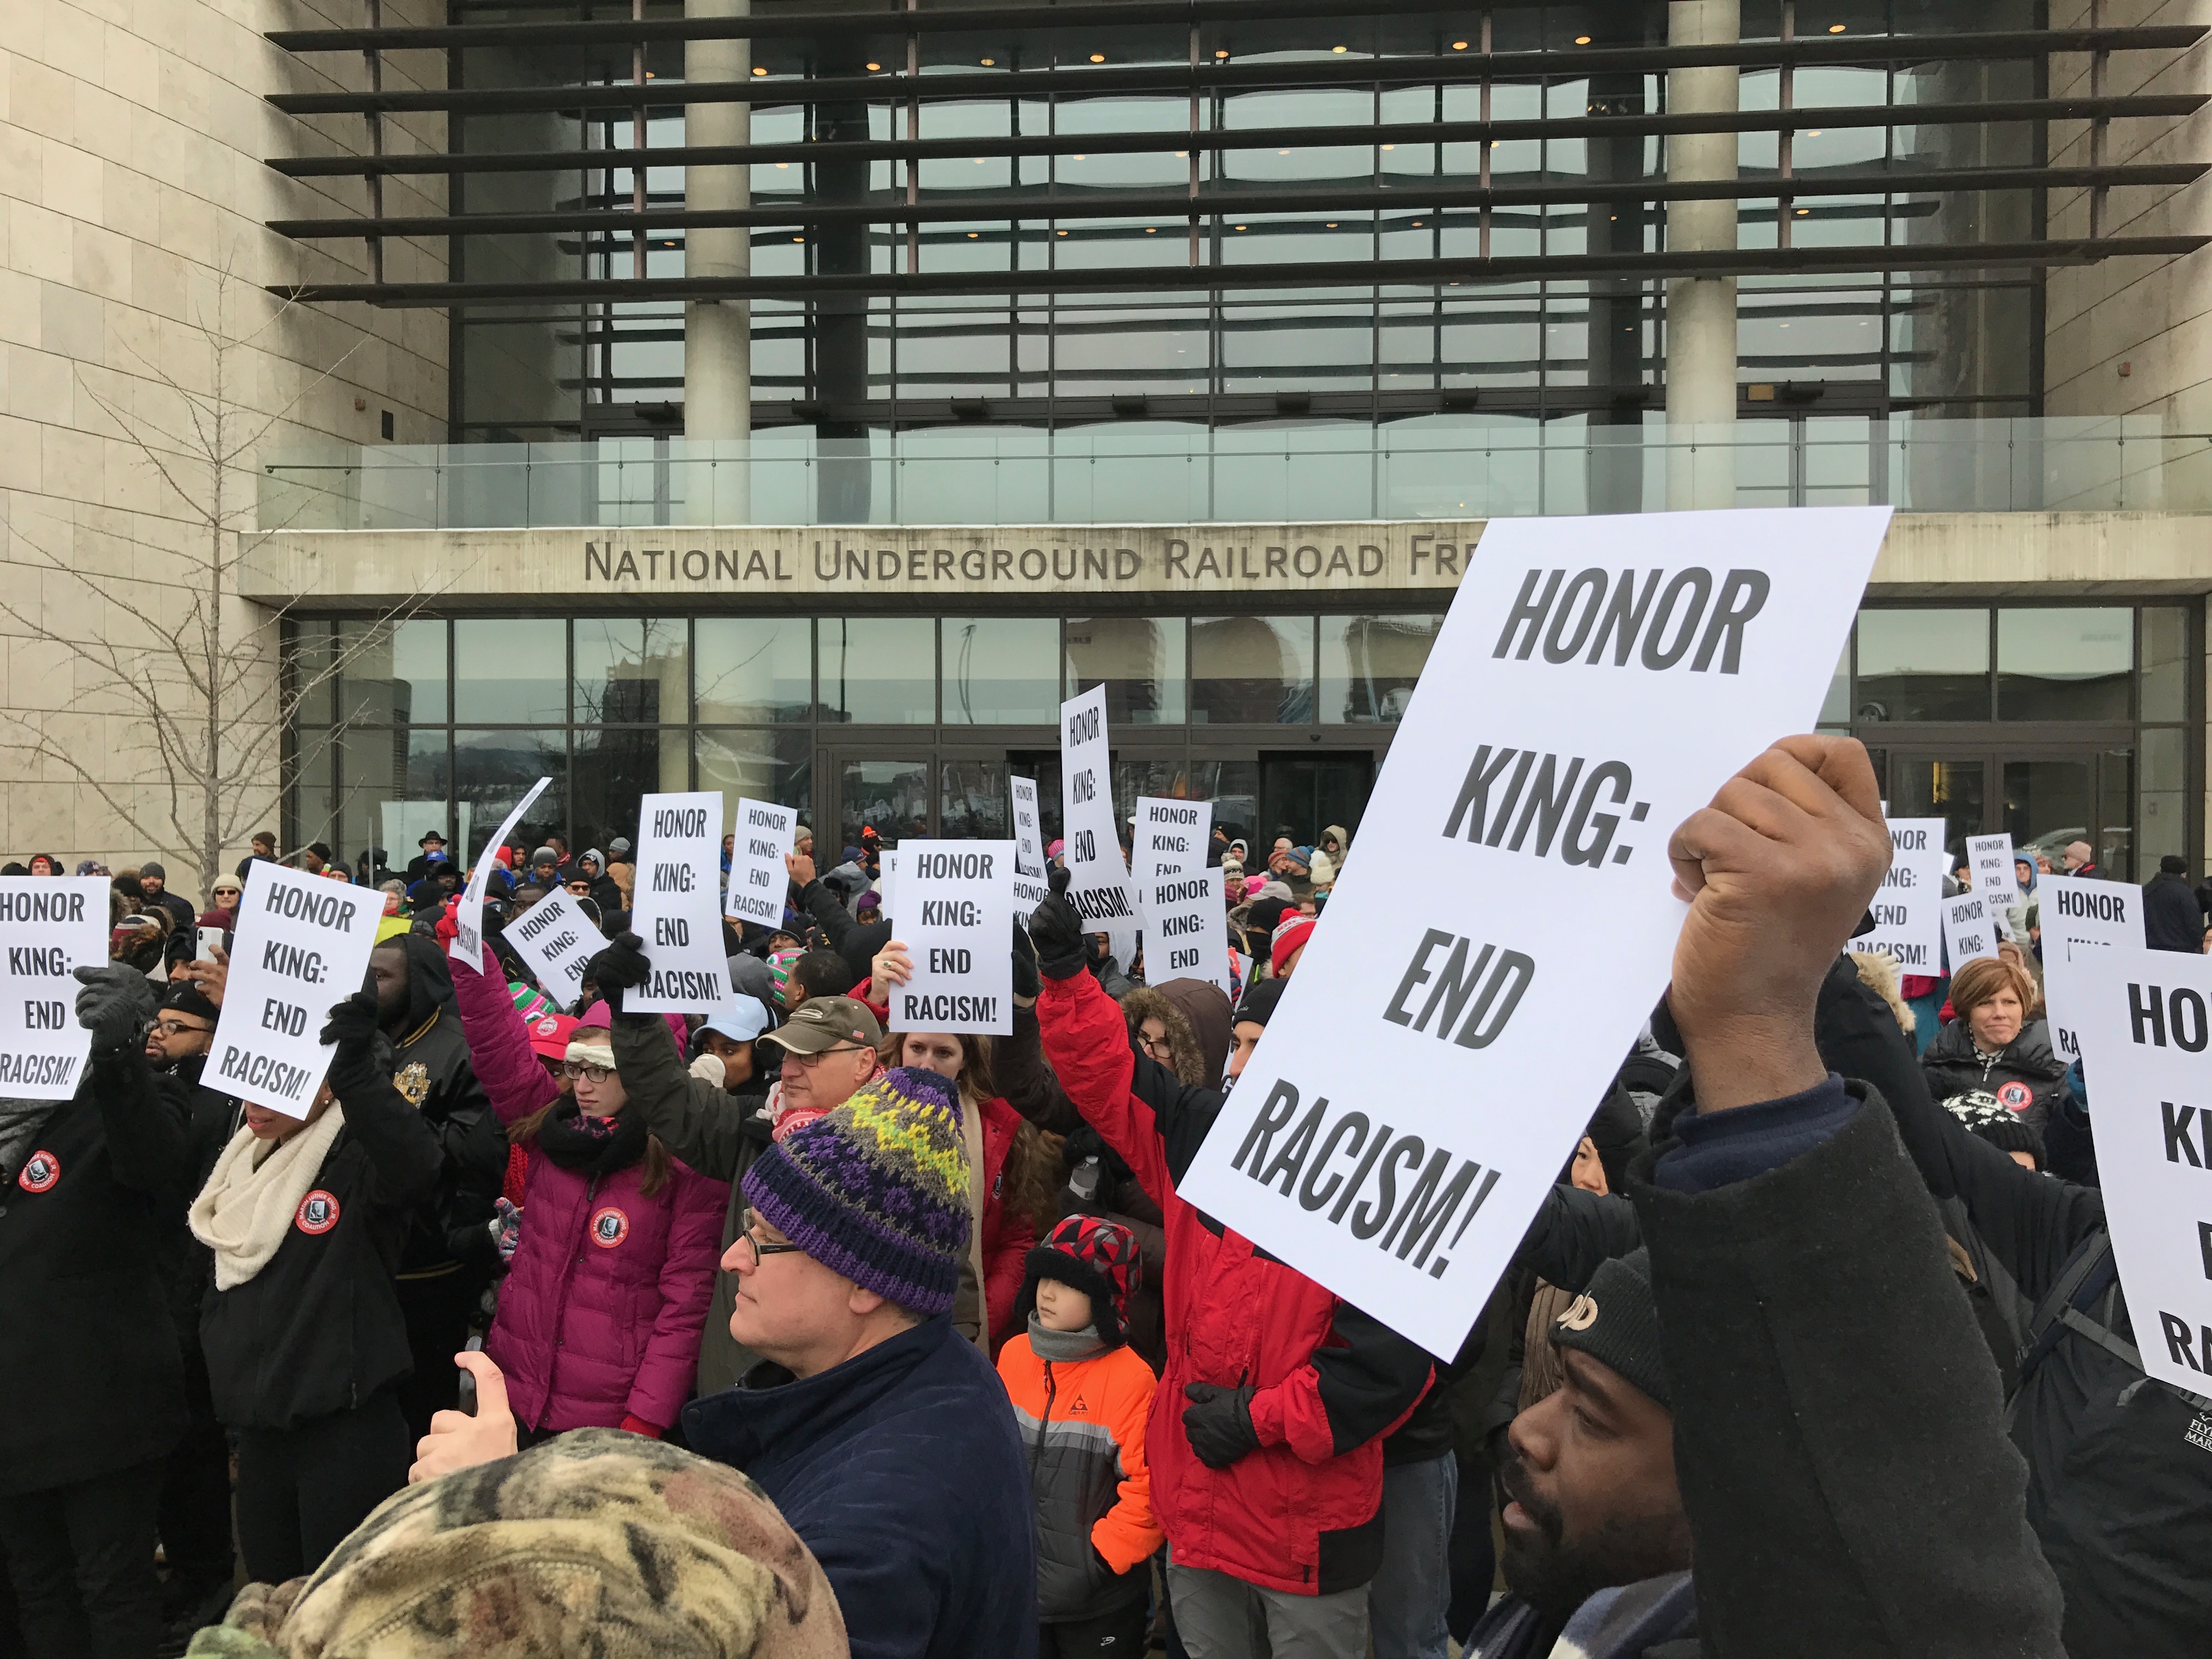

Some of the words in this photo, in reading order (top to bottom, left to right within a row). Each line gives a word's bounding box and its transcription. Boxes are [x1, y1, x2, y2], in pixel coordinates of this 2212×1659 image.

[585, 541, 792, 581] NATIONAL
[815, 540, 1139, 581] UNDERGROUND
[1165, 538, 1384, 579] RAILROAD
[1493, 567, 1770, 674] HONOR
[1070, 707, 1099, 747] HONOR
[1015, 785, 1033, 802] HONOR
[1073, 769, 1096, 804] KING:
[1019, 811, 1032, 827] KING:
[1150, 806, 1198, 825] HONOR
[1443, 745, 1650, 868] KING:
[654, 809, 707, 838] HONOR
[748, 809, 787, 832] HONOR
[749, 838, 778, 859] KING:
[1022, 838, 1031, 854] END
[1075, 830, 1096, 863] END
[1152, 835, 1189, 852] KING:
[1891, 830, 1927, 850] NOR
[1975, 840, 2004, 851] HONOR
[918, 854, 993, 879] HONOR
[1980, 859, 2002, 869] KING:
[653, 864, 696, 893] KING:
[749, 868, 770, 887] END
[1985, 877, 2001, 887] END
[1013, 881, 1048, 902] HONOR
[1066, 886, 1133, 919] RACISM!
[1156, 879, 1209, 905] HONOR
[1989, 894, 2014, 905] CISM!
[0, 893, 84, 922] HONOR
[266, 883, 357, 933] HONOR
[733, 894, 777, 920] RACISM!
[922, 901, 981, 927] KING:
[1875, 905, 1907, 925] END
[1951, 900, 1983, 924] HONOR
[2057, 890, 2125, 923] HONOR
[518, 901, 566, 941] HONOR
[656, 918, 689, 946] END
[1163, 914, 1204, 937] KING:
[541, 930, 579, 962] KING:
[1959, 934, 1984, 956] KING:
[9, 947, 72, 977] KING:
[263, 940, 328, 984] KING:
[564, 955, 590, 981] END
[930, 949, 971, 974] END
[1170, 948, 1199, 969] END
[639, 970, 721, 1001] RACISM!
[1383, 928, 1534, 1049] END
[25, 1001, 65, 1030] END
[261, 998, 307, 1037] END
[905, 995, 997, 1022] RACISM!
[2128, 983, 2212, 1053] HO
[0, 1053, 77, 1085] RACISM!
[219, 1046, 312, 1101] RACISM!
[1231, 1079, 1501, 1279] RACISM!
[302, 1220, 330, 1229] COALITION
